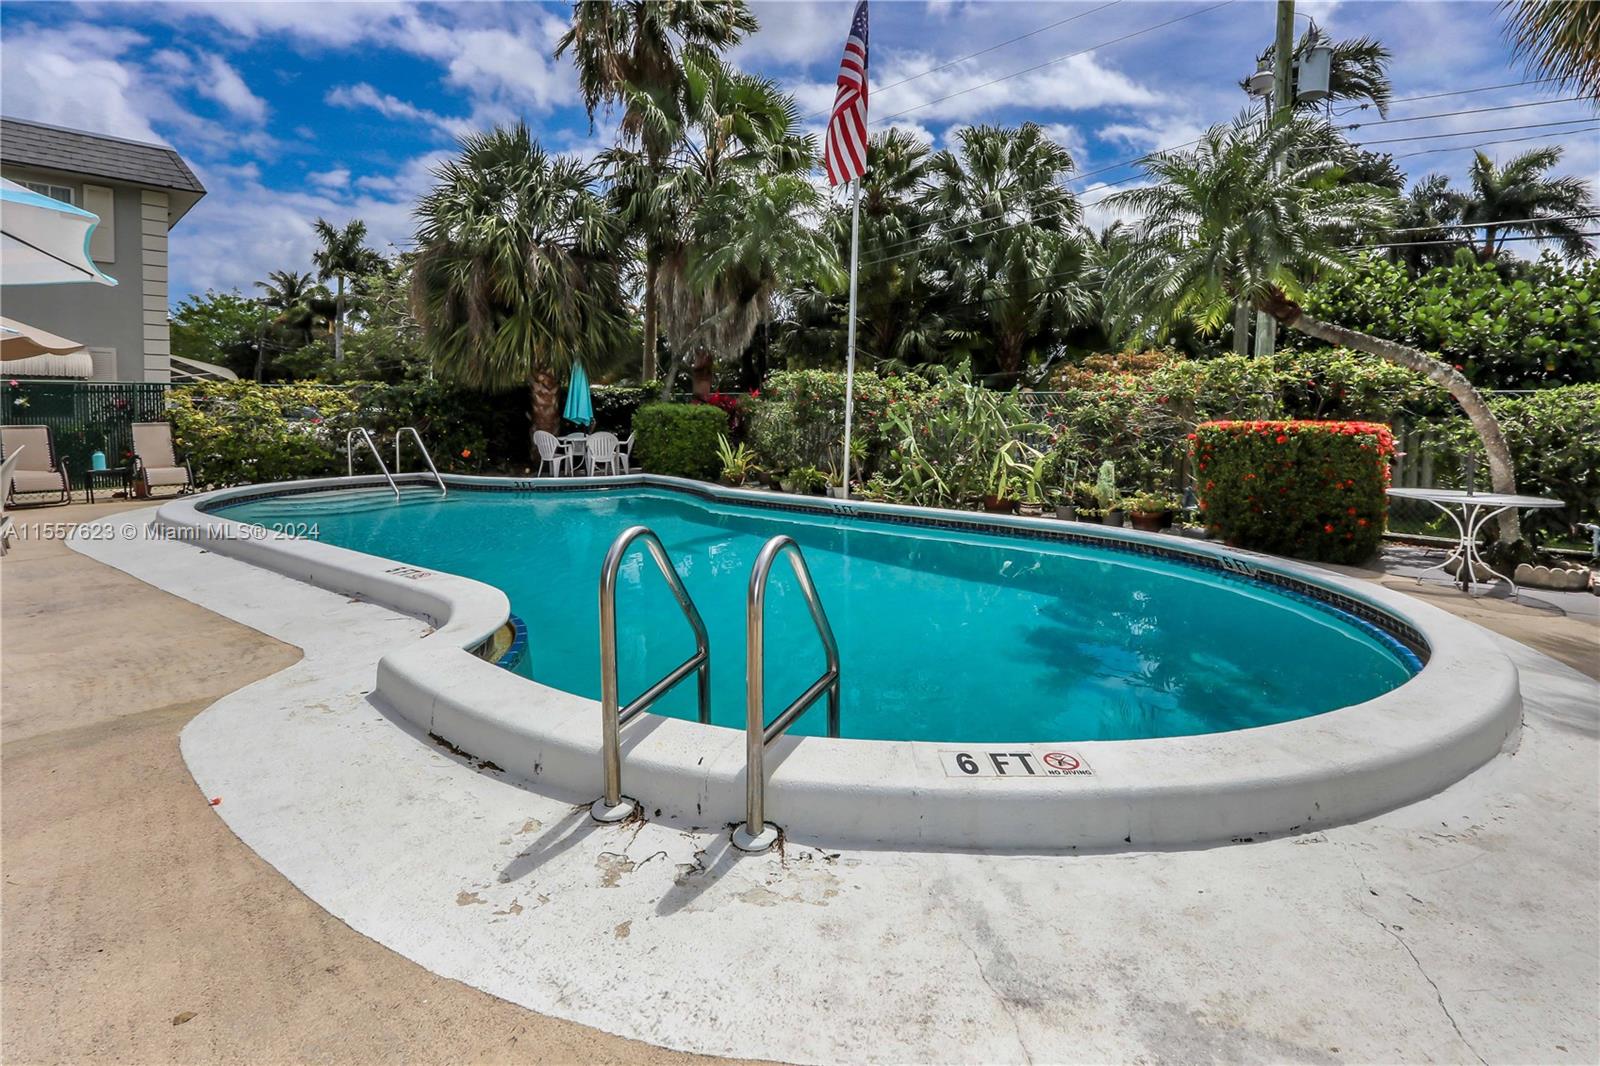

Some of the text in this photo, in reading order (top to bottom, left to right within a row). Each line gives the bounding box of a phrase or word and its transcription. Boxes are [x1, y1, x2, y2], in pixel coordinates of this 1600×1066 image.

[841, 504, 854, 514] FT
[1222, 556, 1251, 574] 6 FT
[956, 752, 1036, 775] 6 FT
